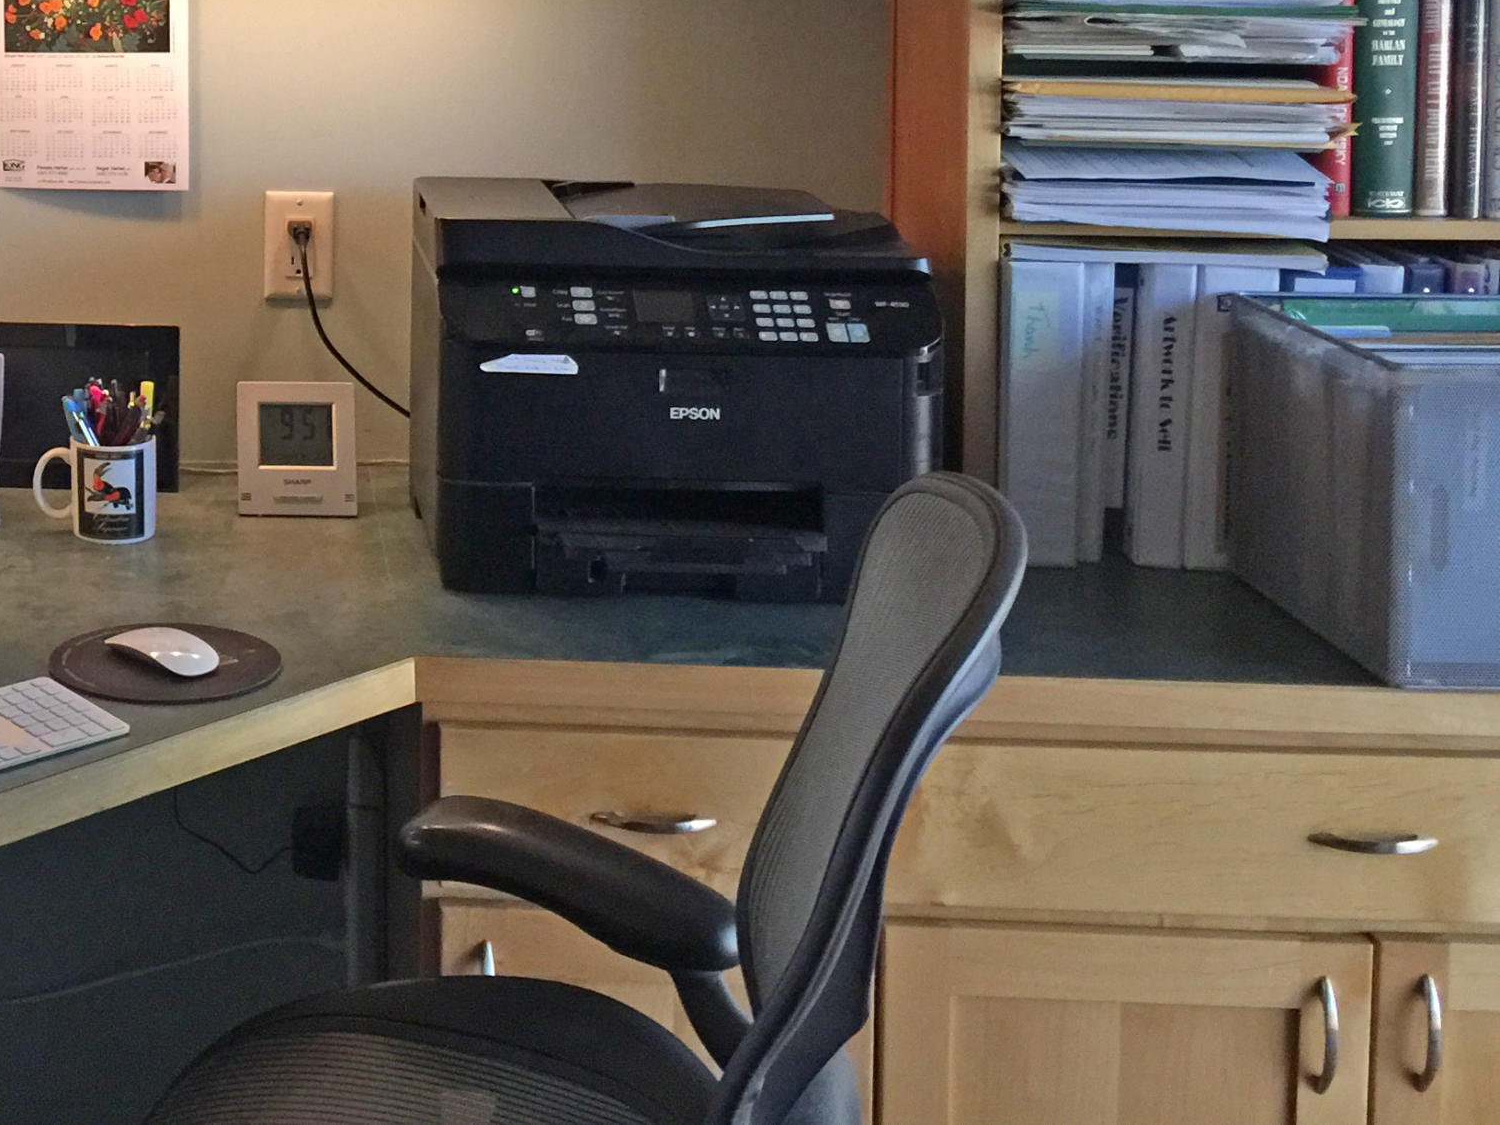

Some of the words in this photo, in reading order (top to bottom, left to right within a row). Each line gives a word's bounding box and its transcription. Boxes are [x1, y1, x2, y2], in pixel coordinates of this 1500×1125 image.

[1371, 53, 1404, 66] FAMILY
[1159, 311, 1179, 391] Artwork
[669, 407, 720, 420] EPSON
